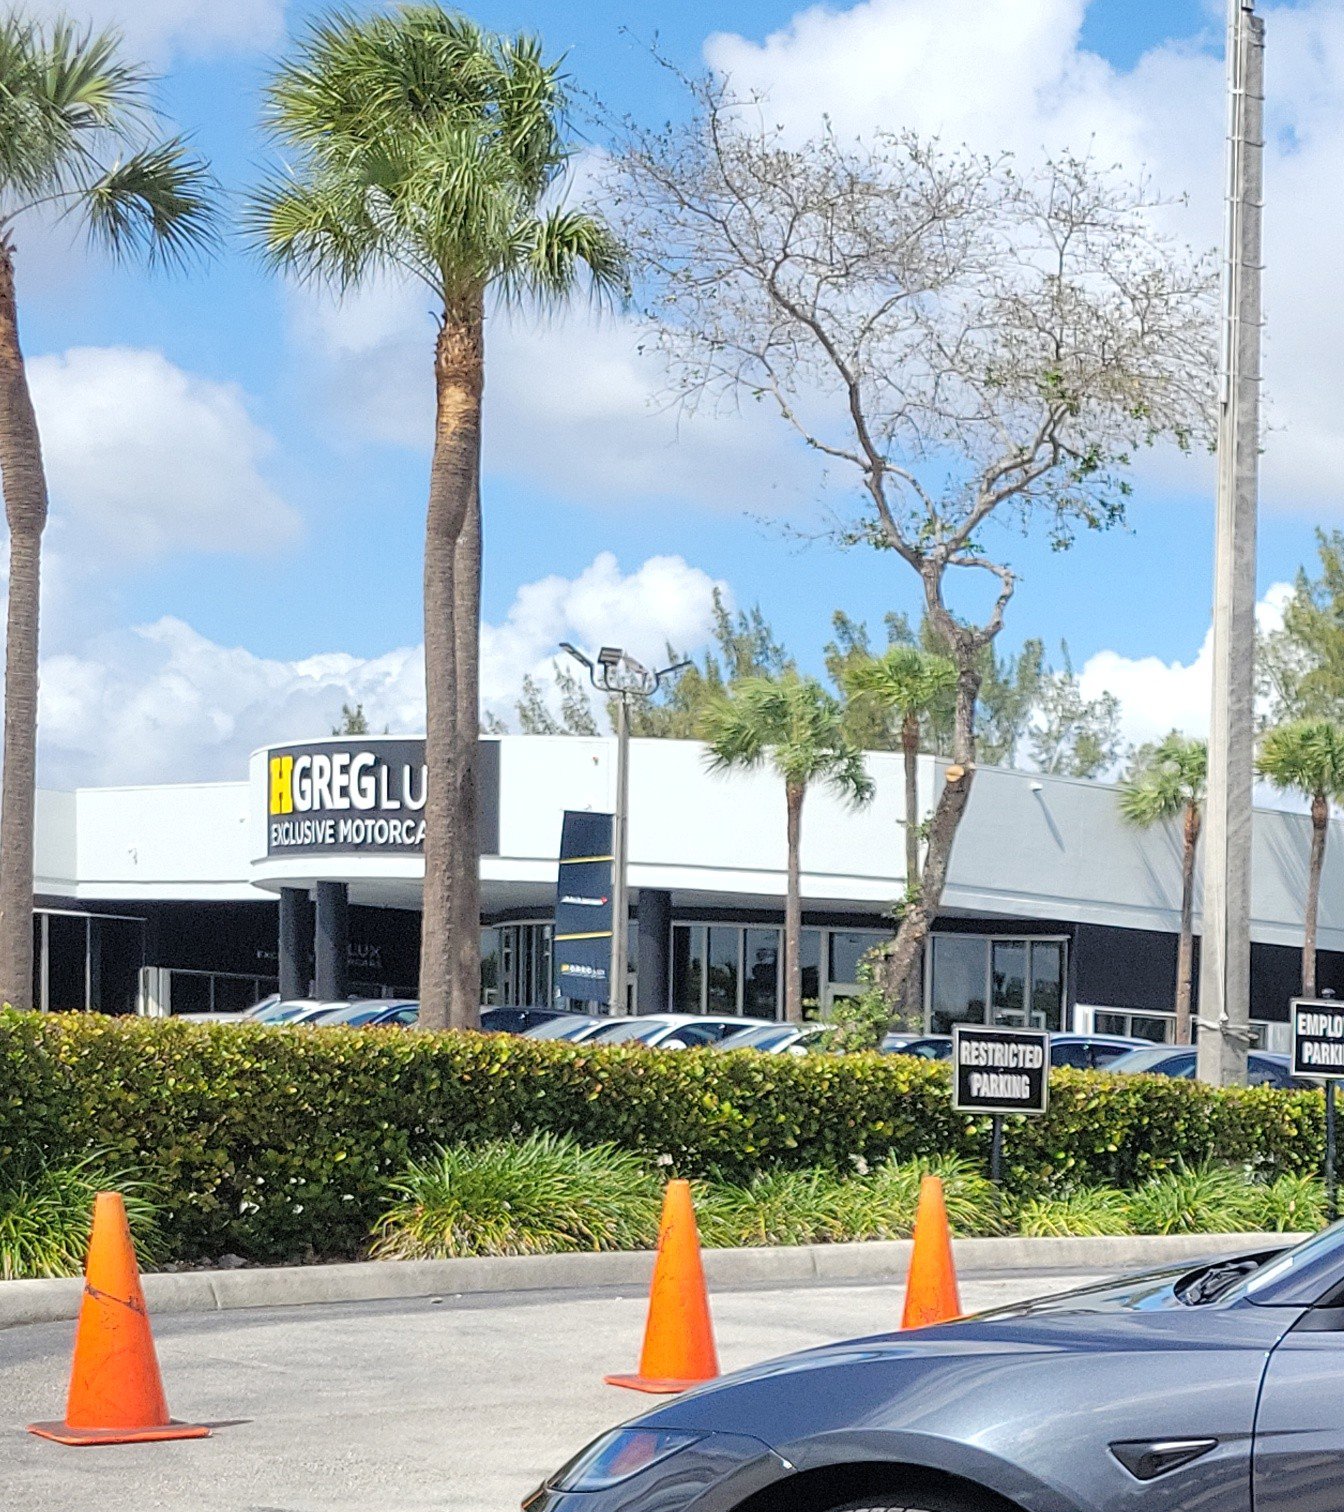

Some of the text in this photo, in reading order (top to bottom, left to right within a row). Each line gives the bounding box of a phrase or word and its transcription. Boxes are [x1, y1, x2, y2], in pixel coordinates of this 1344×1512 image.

[271, 818, 425, 847] EXCLUSIVE MOTORCA
[959, 1040, 1043, 1069] RESTRICTED
[969, 1072, 1030, 1099] PARKING
